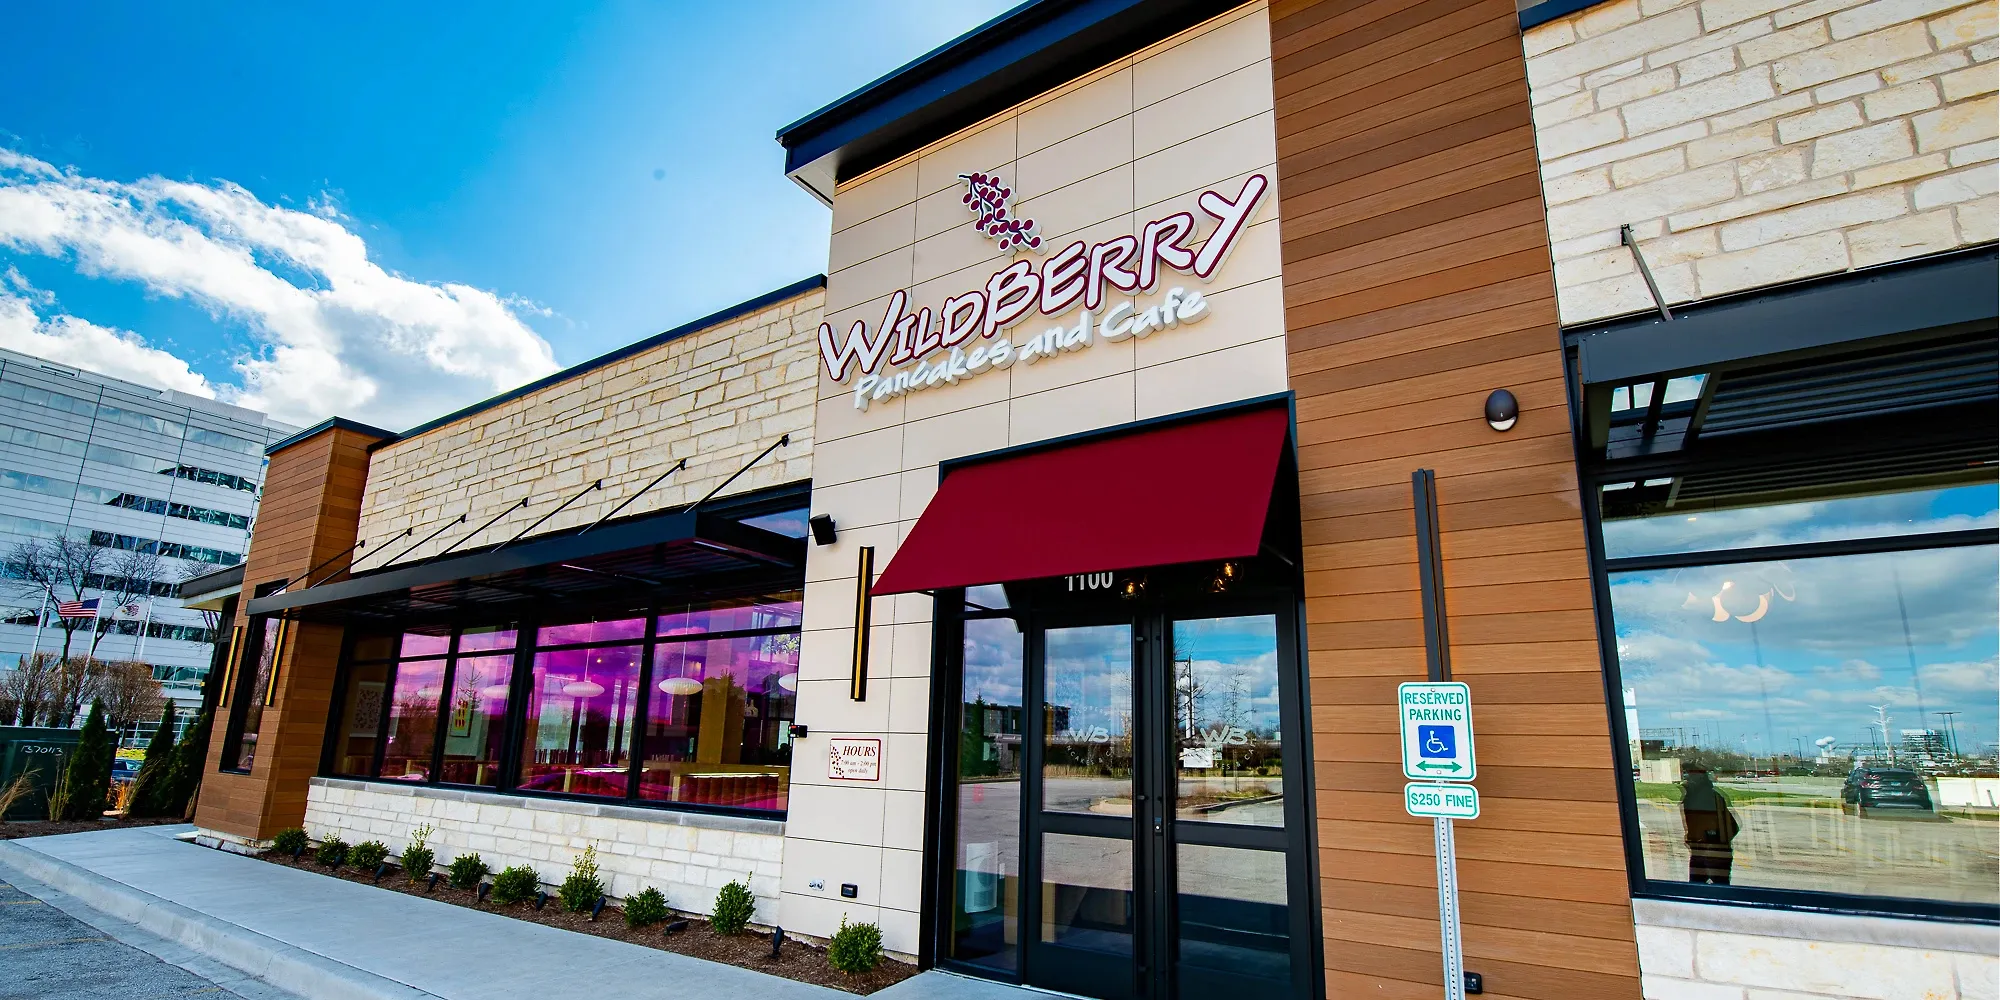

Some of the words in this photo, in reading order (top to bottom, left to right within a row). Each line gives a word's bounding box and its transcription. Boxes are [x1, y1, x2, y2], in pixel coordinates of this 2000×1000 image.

[853, 338, 1015, 411] Pancakes
[1018, 310, 1094, 365] and
[1100, 286, 1211, 343] Cafe
[1404, 692, 1464, 705] RESERVED
[1409, 708, 1462, 721] PARKING
[843, 746, 877, 757] HOURS
[1410, 793, 1441, 806] $250
[1445, 794, 1473, 808] FINE
